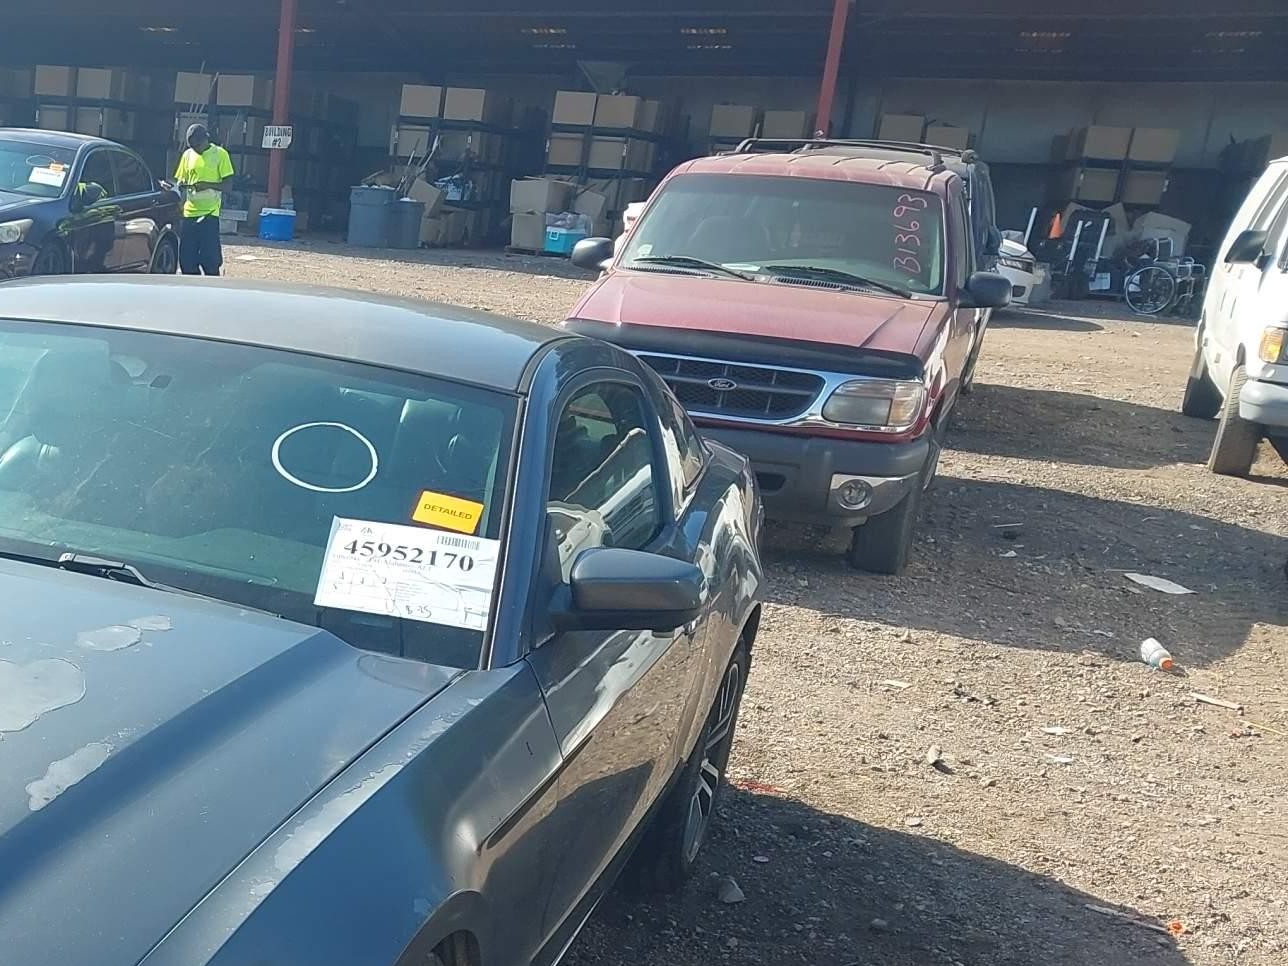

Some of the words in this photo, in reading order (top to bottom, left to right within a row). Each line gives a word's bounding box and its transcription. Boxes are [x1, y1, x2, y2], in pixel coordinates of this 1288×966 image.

[265, 127, 292, 136] BUILDING
[272, 137, 282, 147] #2
[893, 193, 928, 274] B13693
[423, 503, 473, 520] DETAILED
[343, 539, 475, 572] 45952170
